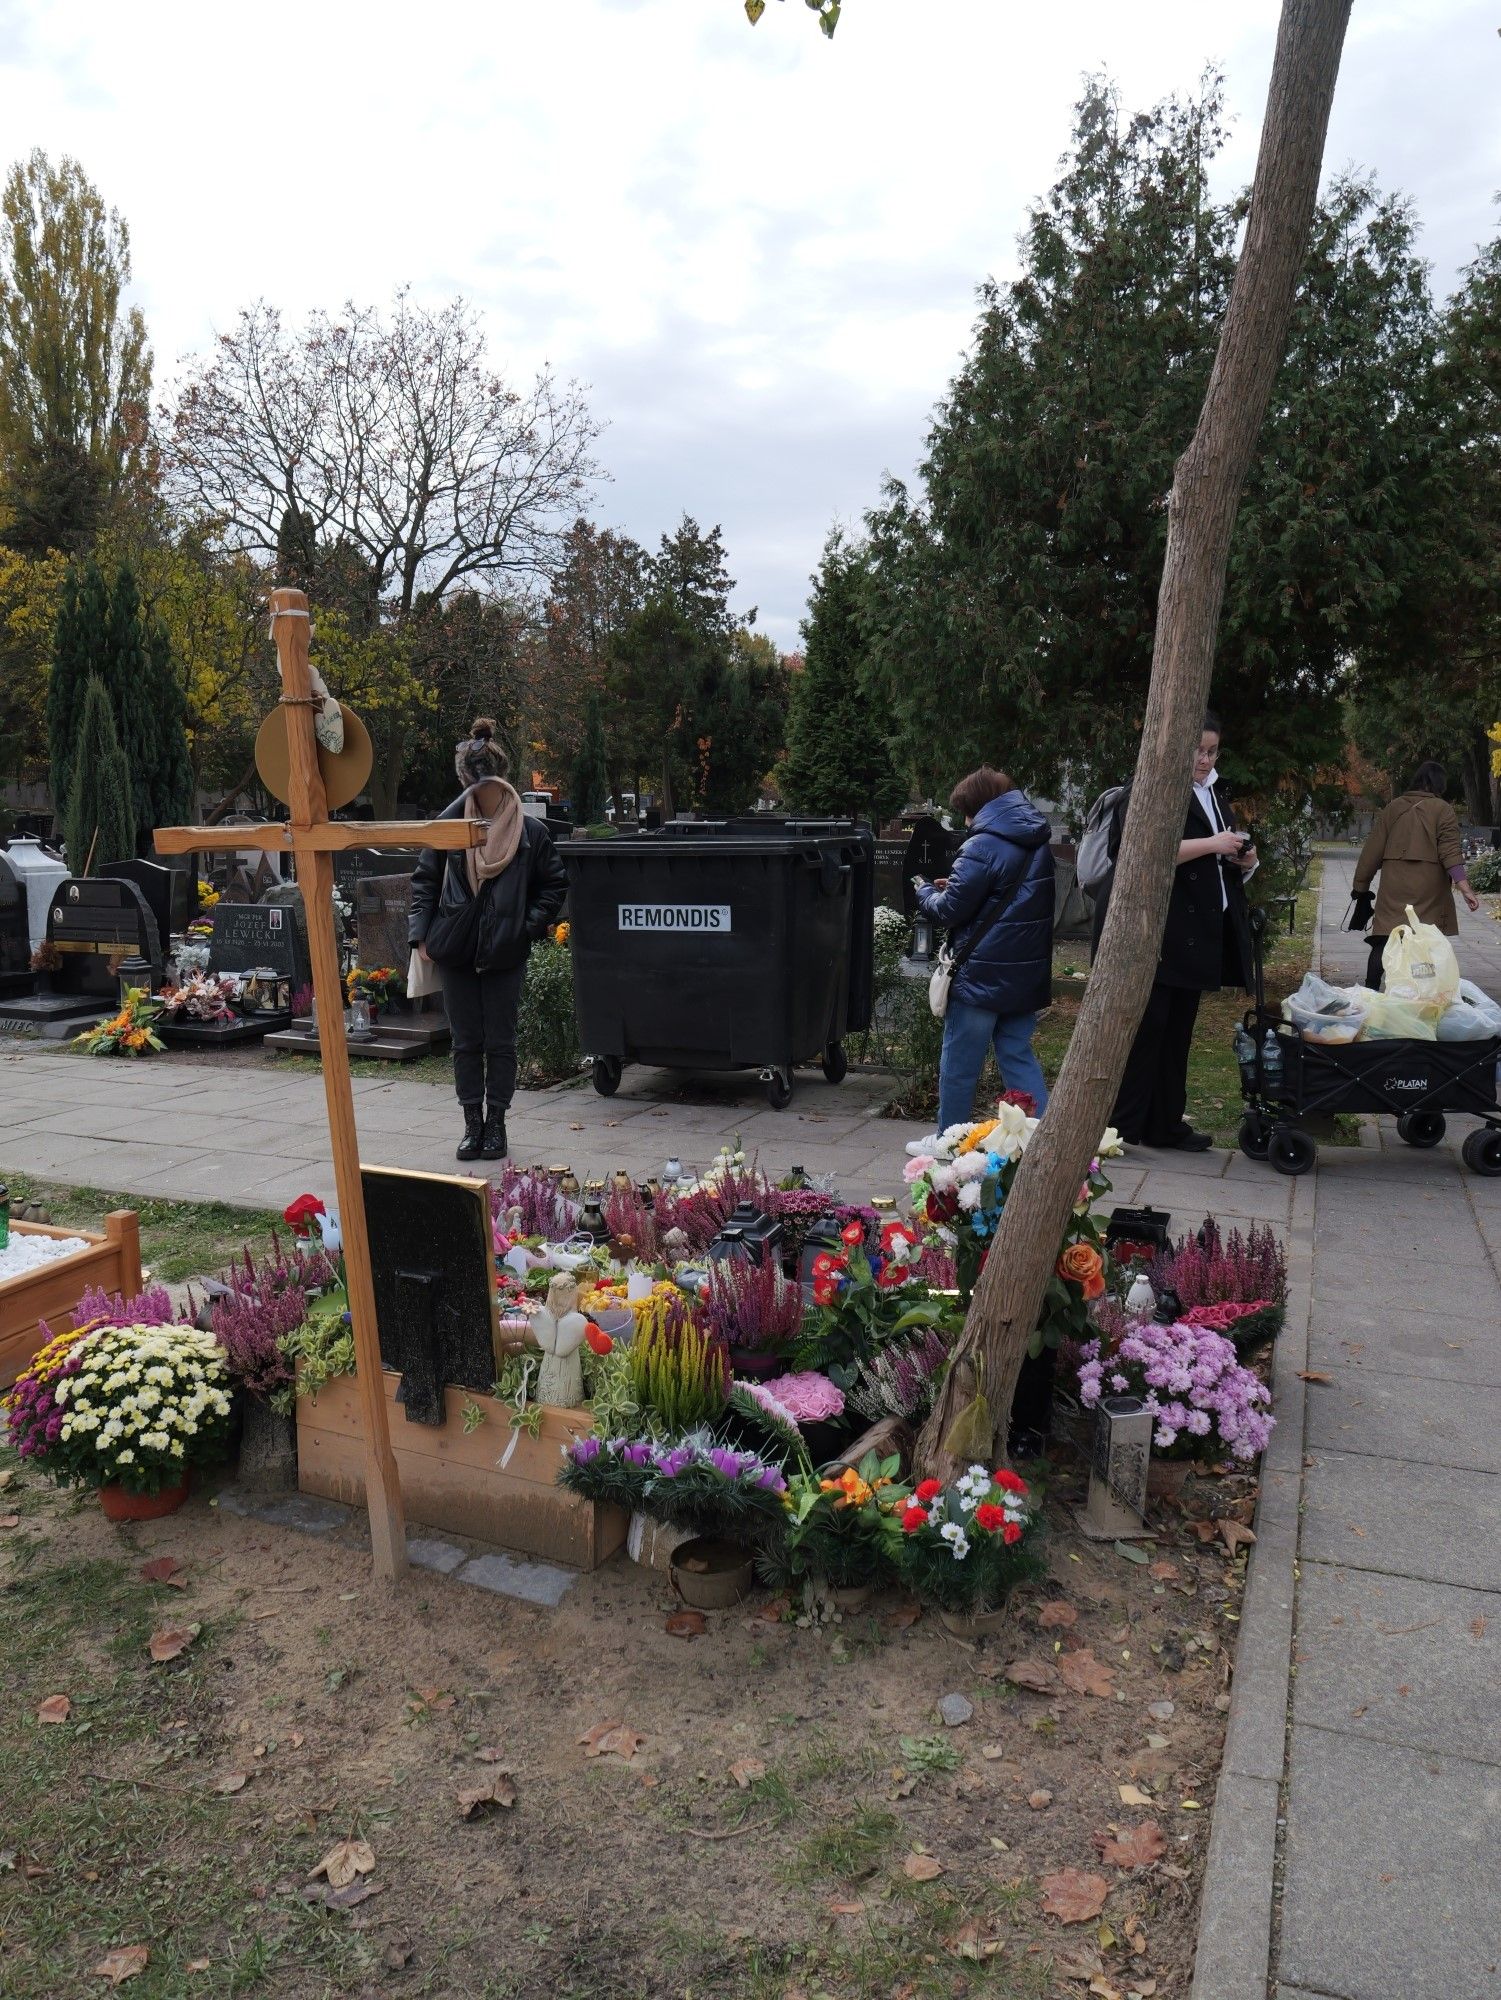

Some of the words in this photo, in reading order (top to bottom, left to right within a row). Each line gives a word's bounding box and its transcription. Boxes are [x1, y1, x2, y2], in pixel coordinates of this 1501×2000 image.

[622, 908, 720, 928] REMONDIS
[225, 929, 276, 940] LEWICKI
[1397, 1079, 1428, 1088] PLATAN
